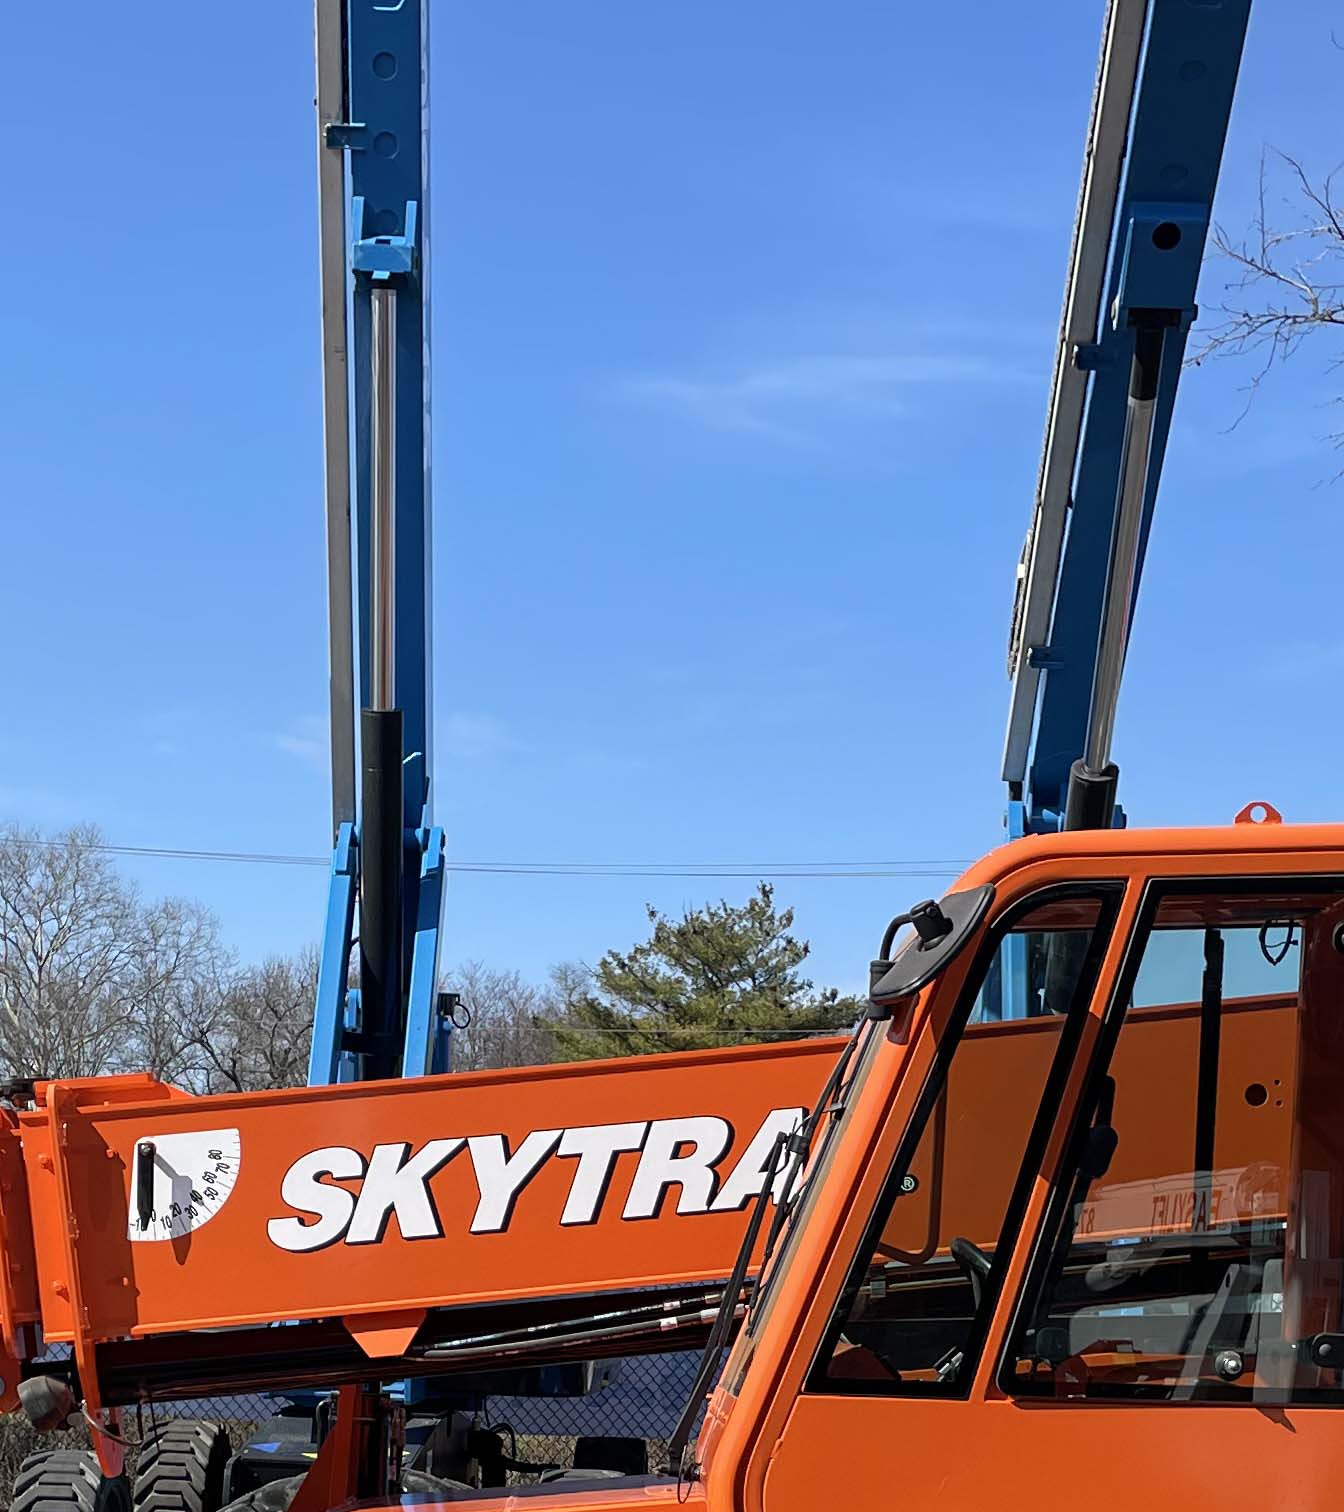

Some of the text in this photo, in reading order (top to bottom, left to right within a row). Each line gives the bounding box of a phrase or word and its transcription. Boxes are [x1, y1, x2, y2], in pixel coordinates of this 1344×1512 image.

[215, 1163, 230, 1174] 70
[203, 1187, 218, 1200] 50
[169, 1202, 182, 1217] 20
[184, 1204, 198, 1219] 30
[160, 1215, 172, 1230] 10
